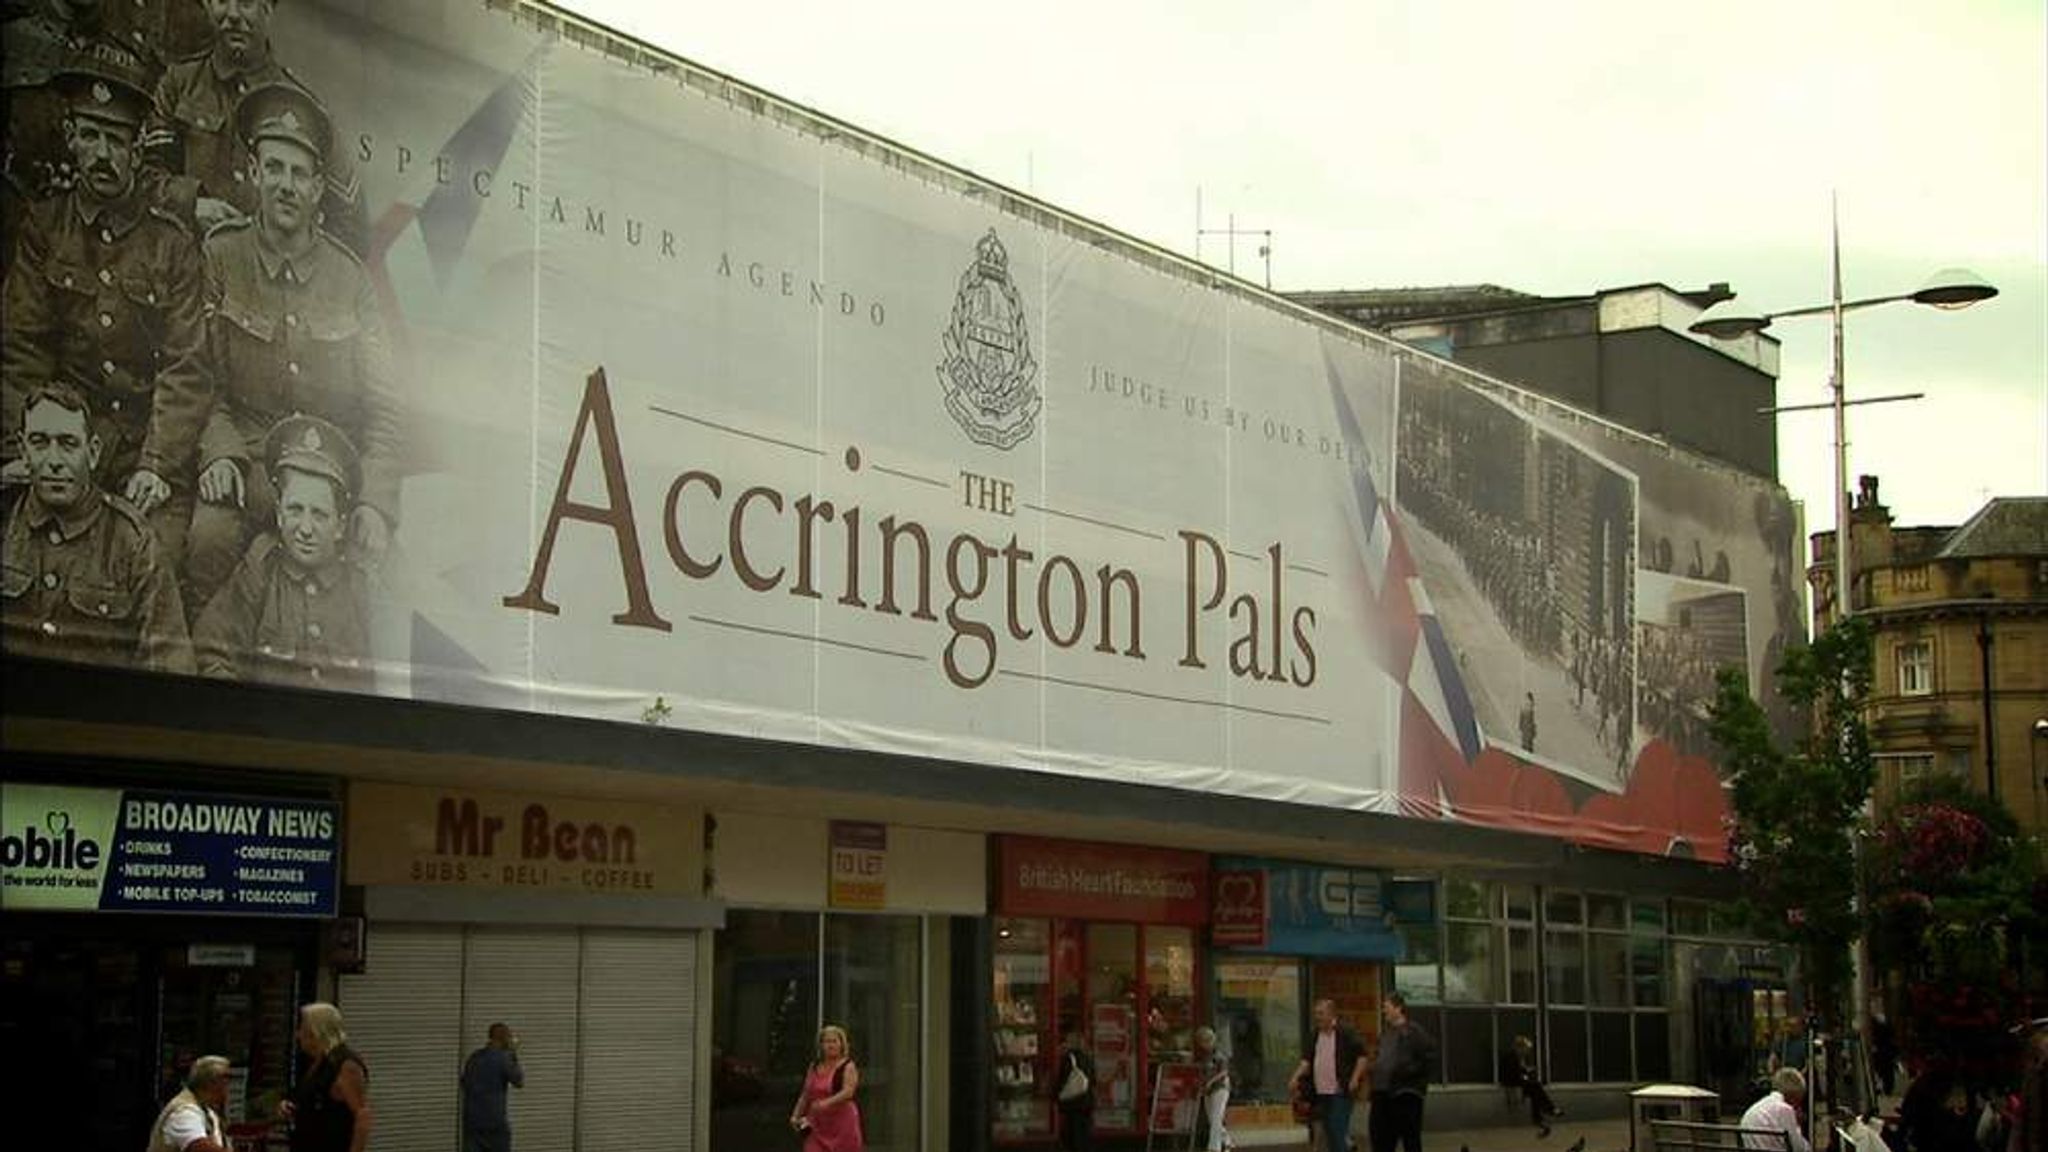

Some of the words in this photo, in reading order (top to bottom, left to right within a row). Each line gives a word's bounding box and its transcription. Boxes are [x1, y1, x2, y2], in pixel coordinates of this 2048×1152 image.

[358, 134, 677, 258] SPECTAMUR
[717, 253, 886, 327] AGENDO
[1090, 366, 1169, 410] JUDGE
[1184, 396, 1210, 421] US
[1224, 407, 1250, 431] BY
[1263, 418, 1305, 447] OUR
[959, 470, 1015, 516] THE
[503, 365, 1147, 690] Accrington
[1177, 530, 1318, 689] Pals
[124, 800, 262, 836] BROADWAY
[268, 810, 335, 839] NEWS
[435, 798, 504, 856] Mr
[521, 803, 636, 865] Bean
[125, 840, 172, 855] DRINKS
[239, 846, 332, 862] CONFECTIONERY
[4, 874, 22, 887] the
[24, 875, 57, 887] world
[58, 875, 73, 888] for
[76, 877, 98, 888] less
[124, 863, 206, 879] NEWSPAPERS
[238, 867, 305, 883] MAGAZINES
[410, 861, 468, 882] SUBS
[503, 865, 549, 886] DELI
[581, 868, 655, 890] COFFEE
[123, 885, 170, 901] MOBILE
[174, 887, 224, 902] TOP-UPS
[239, 889, 318, 905] TOBACCONIST
